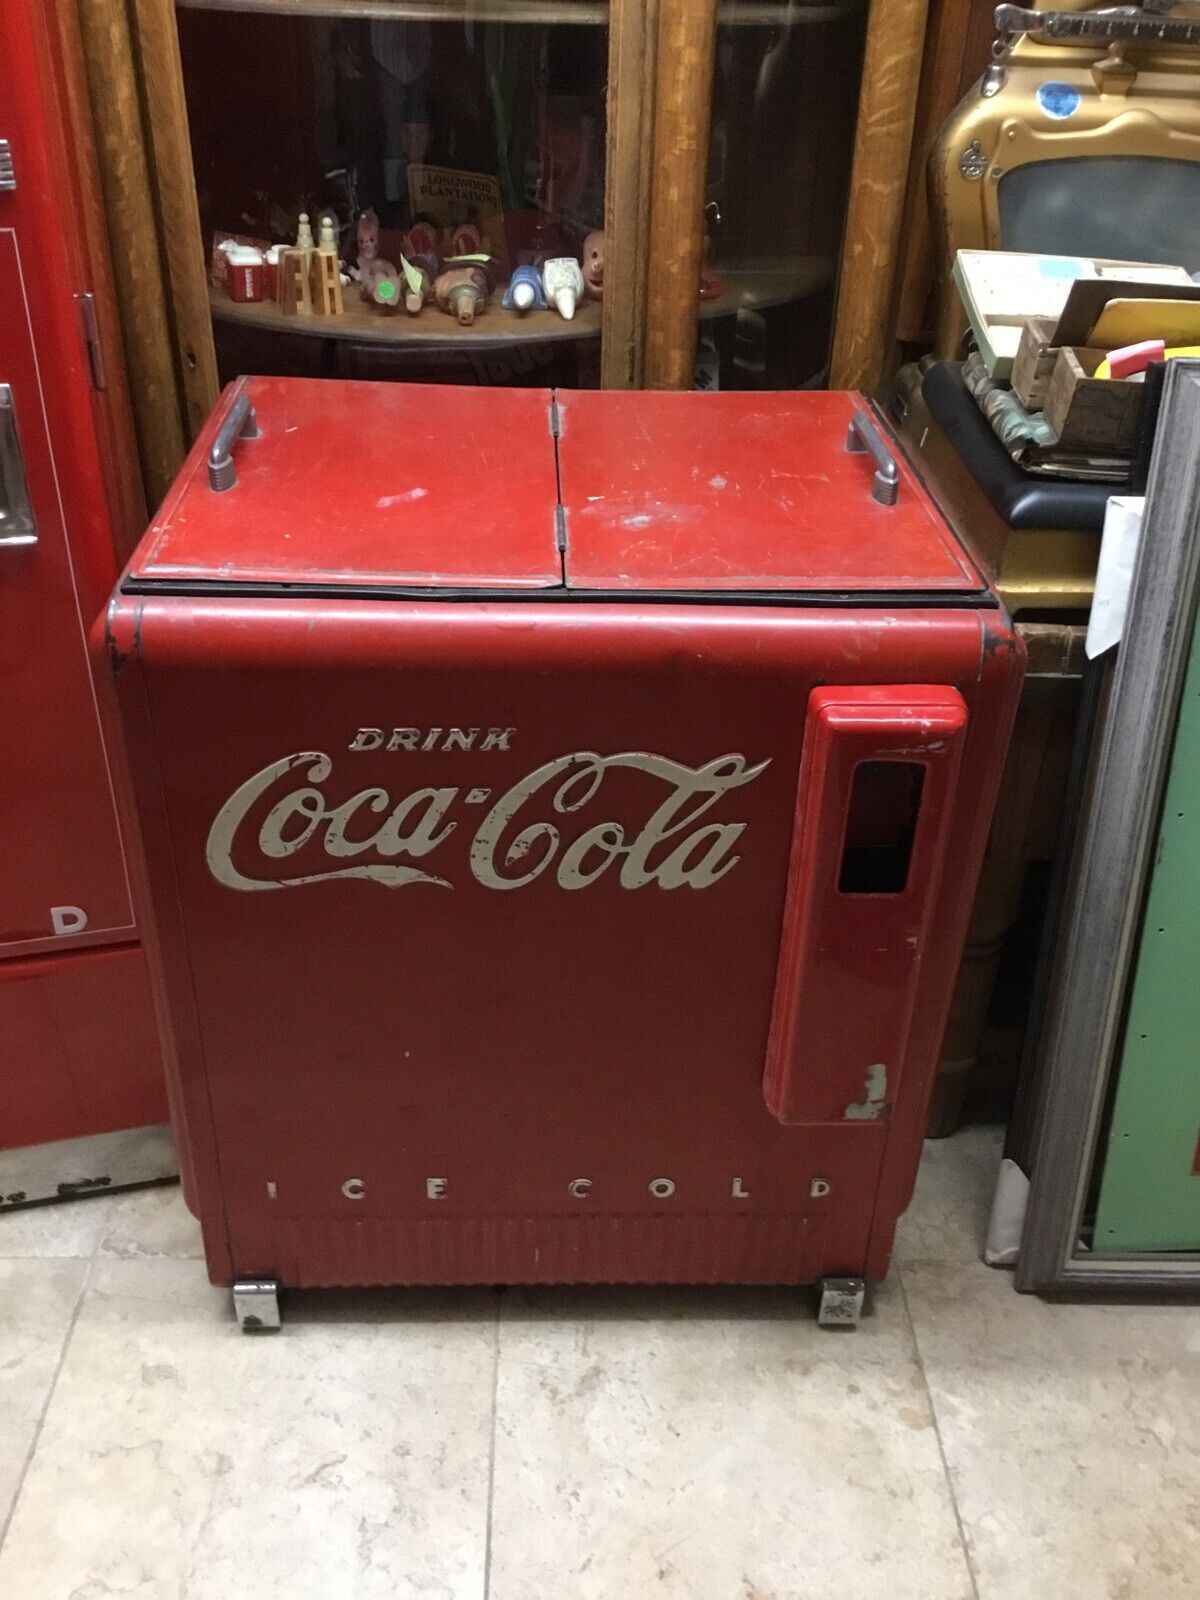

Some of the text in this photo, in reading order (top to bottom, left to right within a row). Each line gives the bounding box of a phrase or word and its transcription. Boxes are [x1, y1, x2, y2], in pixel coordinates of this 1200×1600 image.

[348, 727, 517, 752] DRINK
[205, 751, 773, 892] Coca-Cola
[50, 905, 88, 936] D
[266, 1177, 832, 1200] ICE COLD
